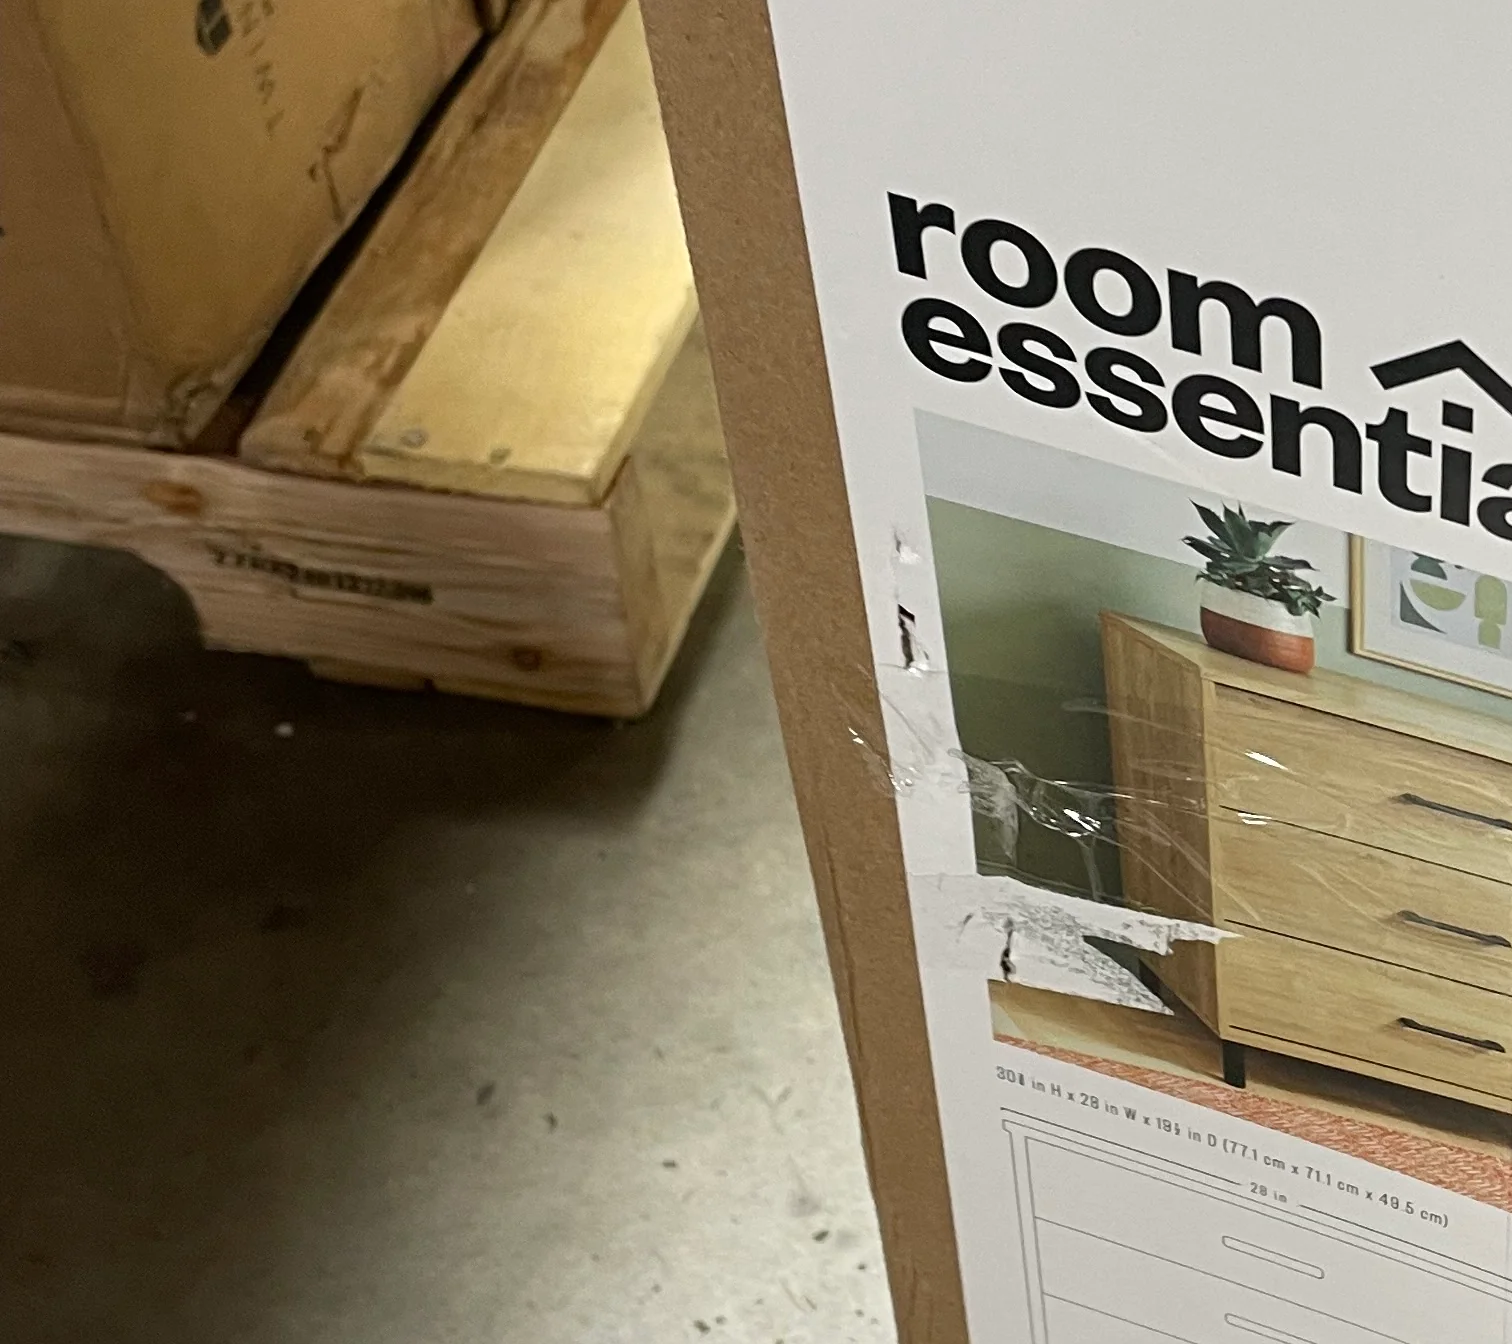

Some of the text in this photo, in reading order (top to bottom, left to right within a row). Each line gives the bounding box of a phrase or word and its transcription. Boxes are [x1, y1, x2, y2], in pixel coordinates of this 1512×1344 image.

[886, 190, 1323, 391] room
[1050, 1082, 1062, 1098] H
[1080, 1092, 1099, 1109] 28
[1187, 1126, 1202, 1143] in
[1207, 1133, 1217, 1148] D
[1263, 1155, 1286, 1171] cm
[1290, 1165, 1300, 1175] x
[1336, 1179, 1360, 1196] cm
[1365, 1191, 1374, 1201] x
[1420, 1209, 1449, 1228] cm)
[1249, 1181, 1268, 1198] 28
